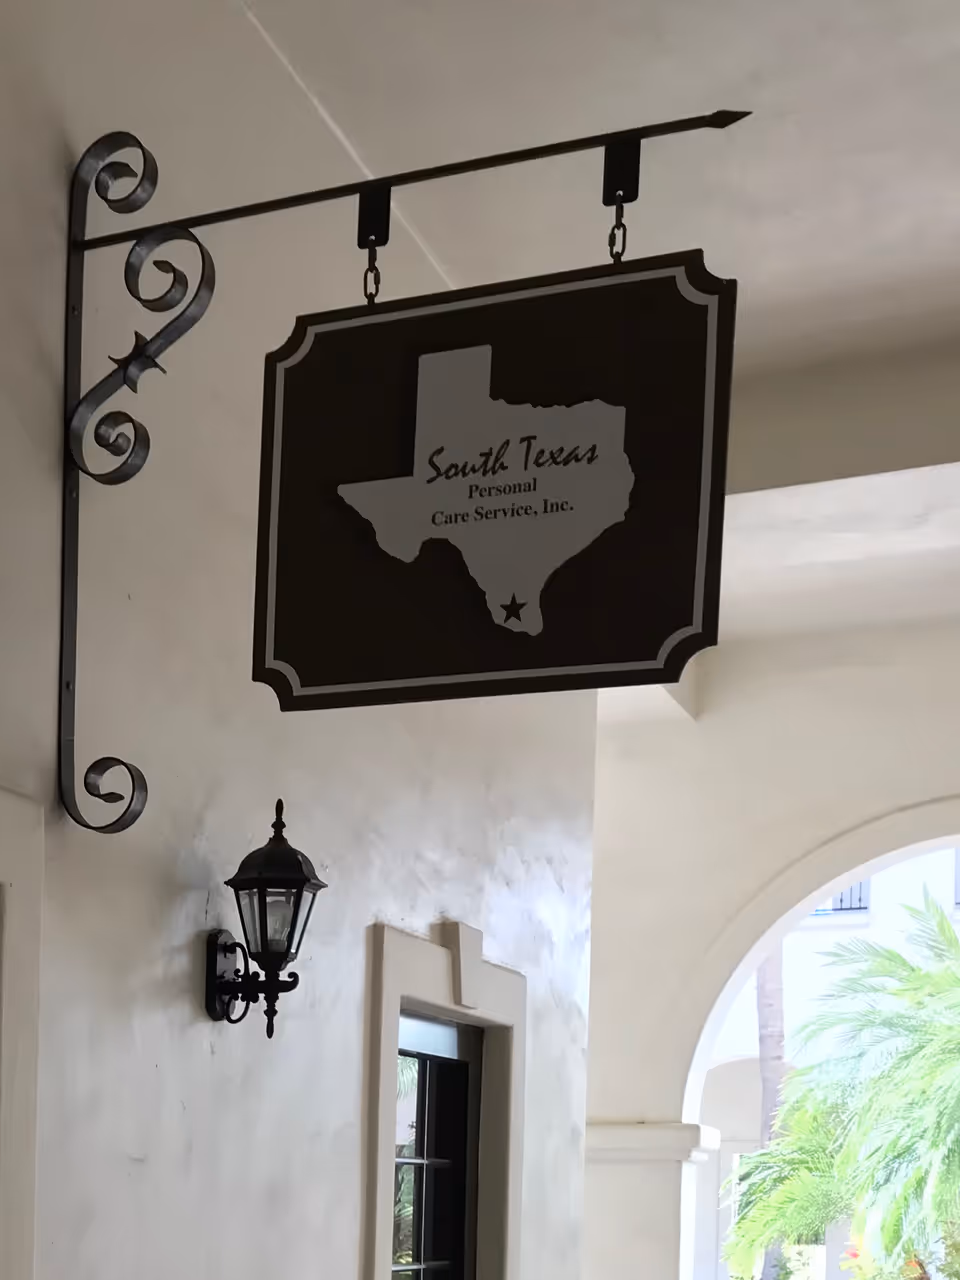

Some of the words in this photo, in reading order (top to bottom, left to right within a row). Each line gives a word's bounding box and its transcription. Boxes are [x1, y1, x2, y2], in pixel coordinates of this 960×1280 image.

[426, 439, 511, 484] South
[519, 435, 599, 471] Texas
[468, 477, 537, 499] Personal
[431, 510, 470, 527] Care
[474, 502, 538, 521] Service,
[542, 498, 574, 514] Inc.
